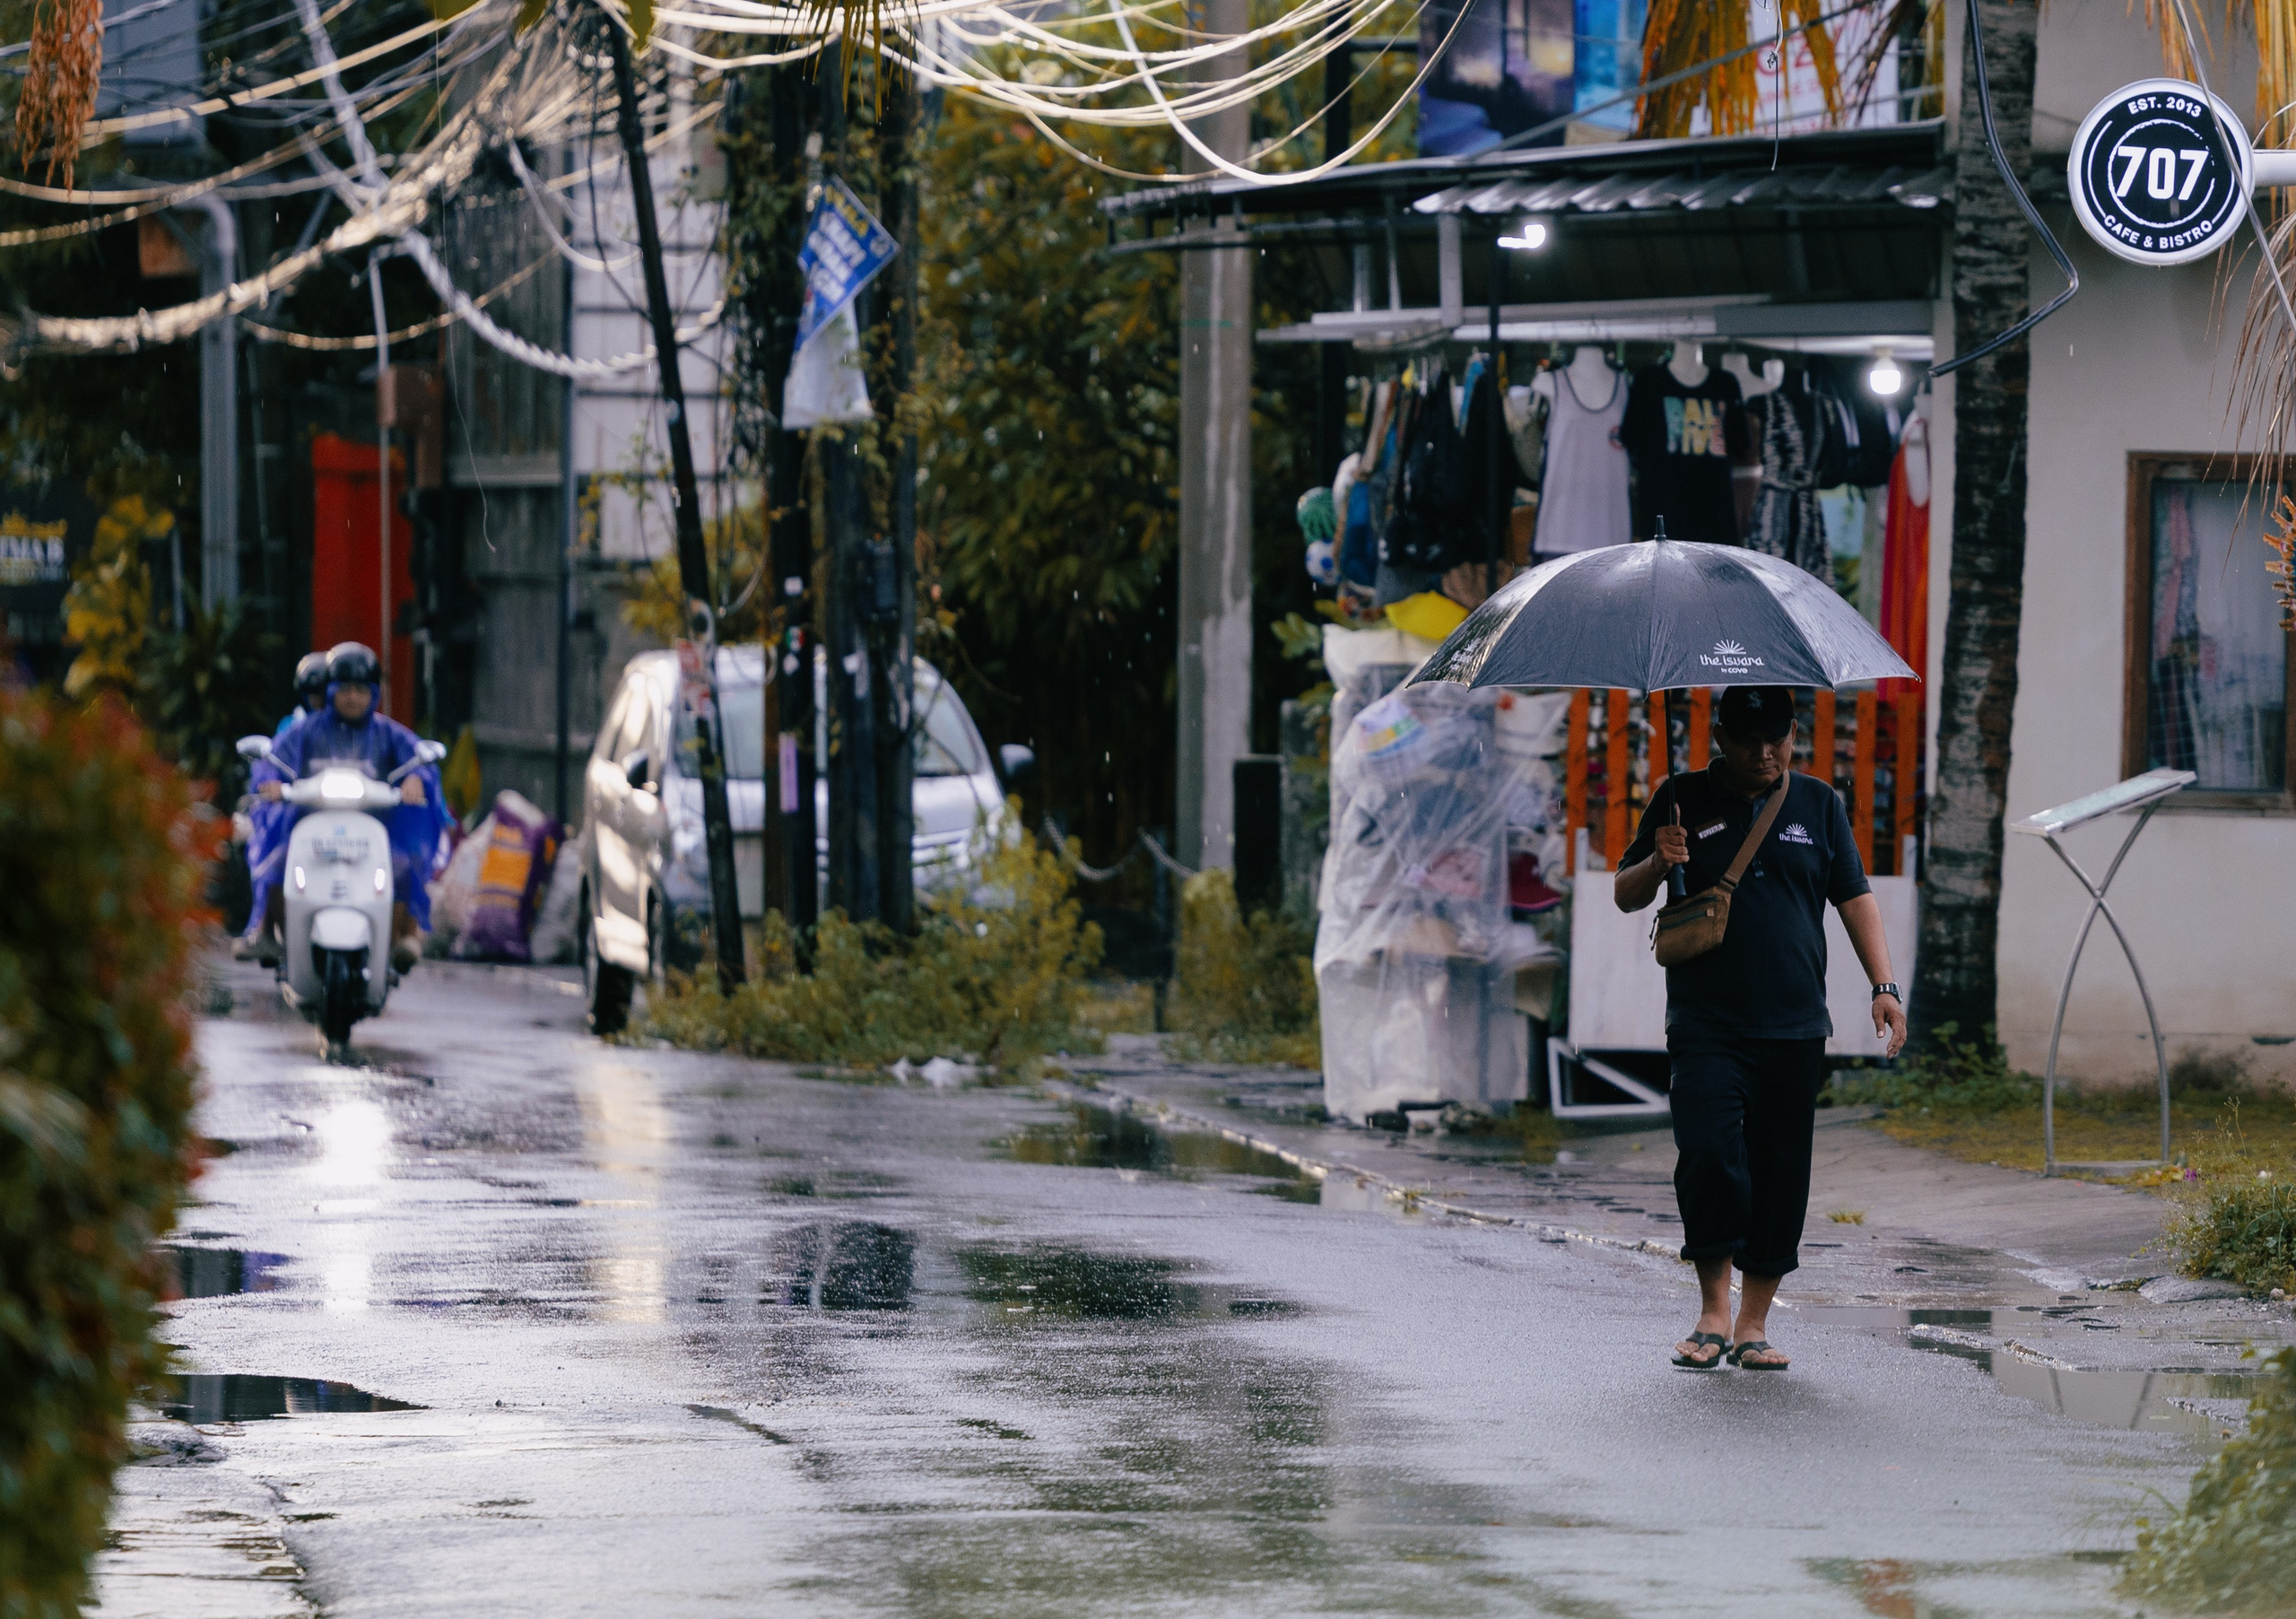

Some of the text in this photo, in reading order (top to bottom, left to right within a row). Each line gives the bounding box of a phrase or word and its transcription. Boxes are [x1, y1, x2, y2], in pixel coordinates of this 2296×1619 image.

[2127, 96, 2202, 118] EST. 2013
[2117, 145, 2209, 201] 707
[2104, 214, 2213, 249] CAFE & BISTRO
[1700, 654, 1722, 666] the
